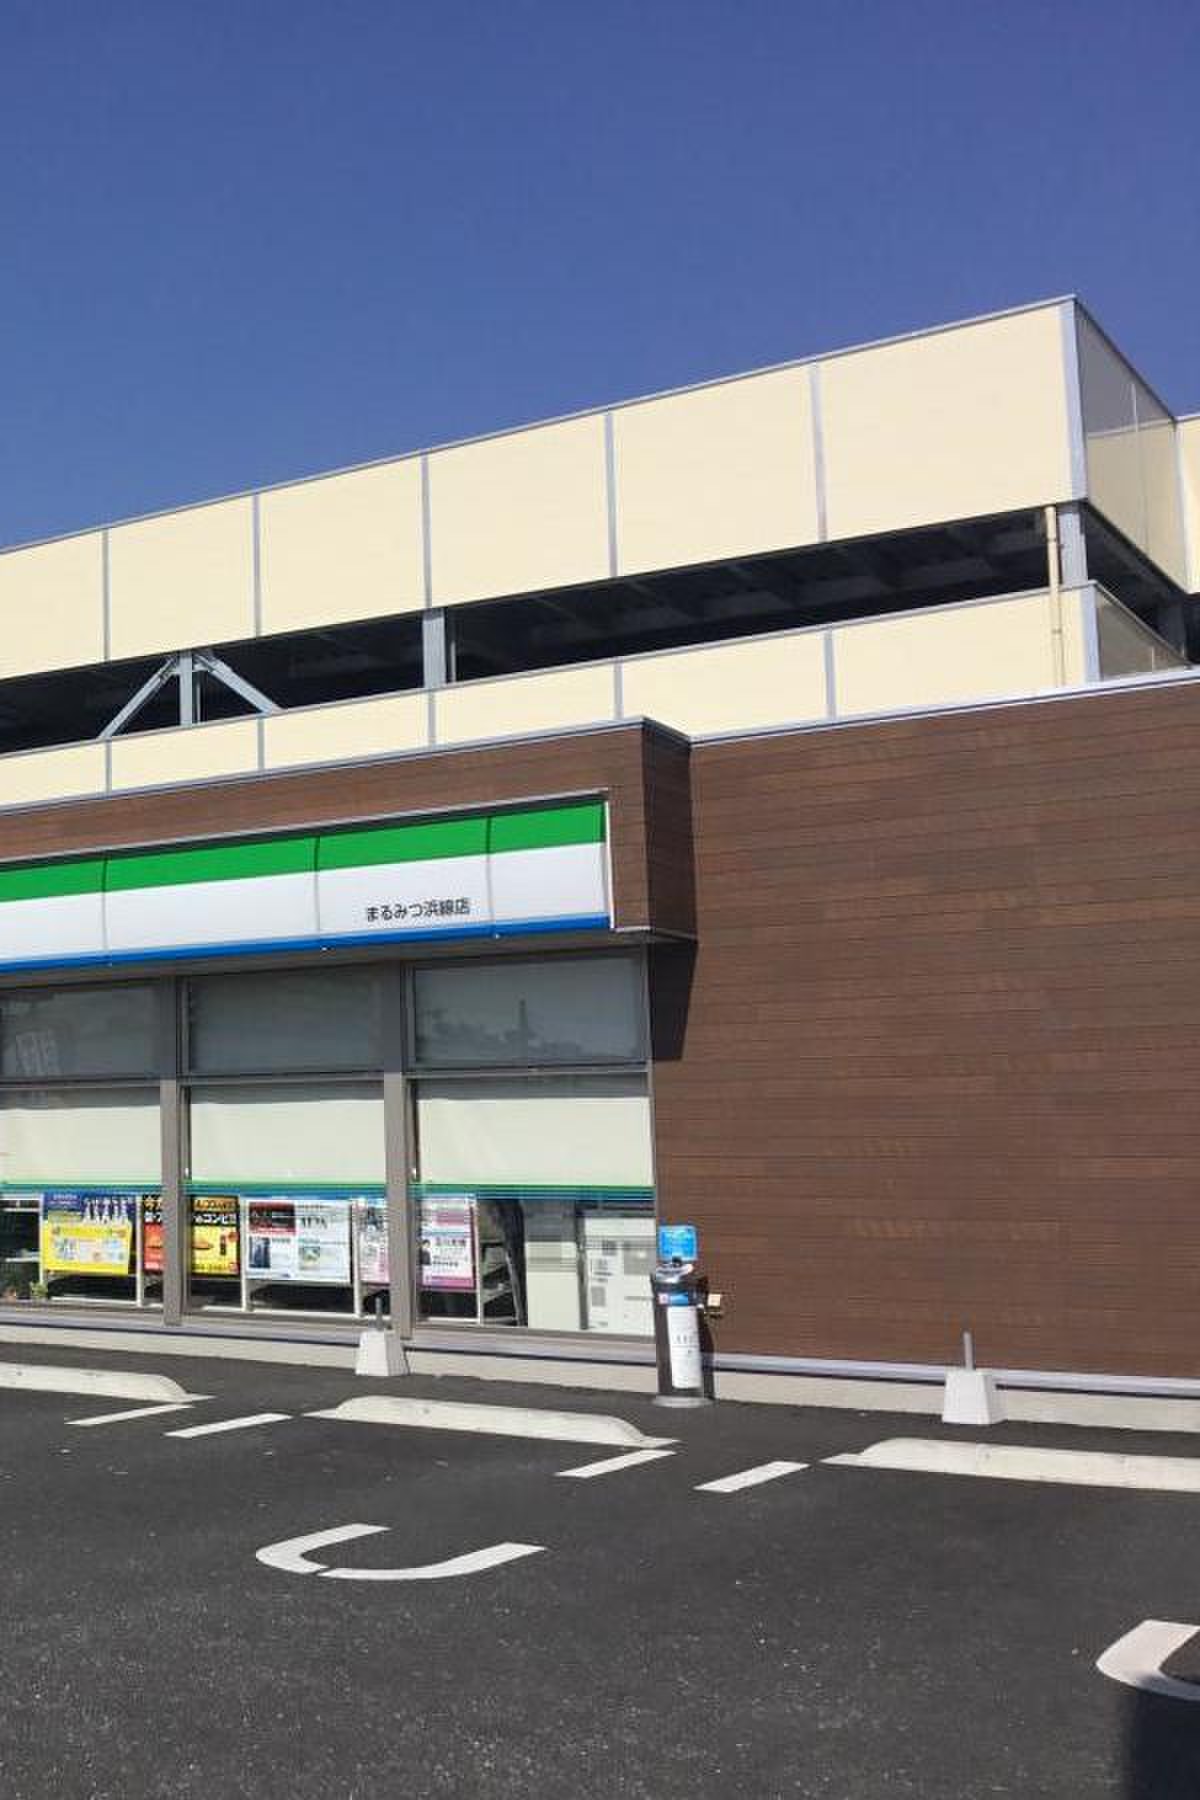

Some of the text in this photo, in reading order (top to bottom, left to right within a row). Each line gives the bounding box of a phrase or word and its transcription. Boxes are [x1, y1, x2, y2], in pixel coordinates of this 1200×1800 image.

[367, 897, 471, 921] まるみつ浜線店
